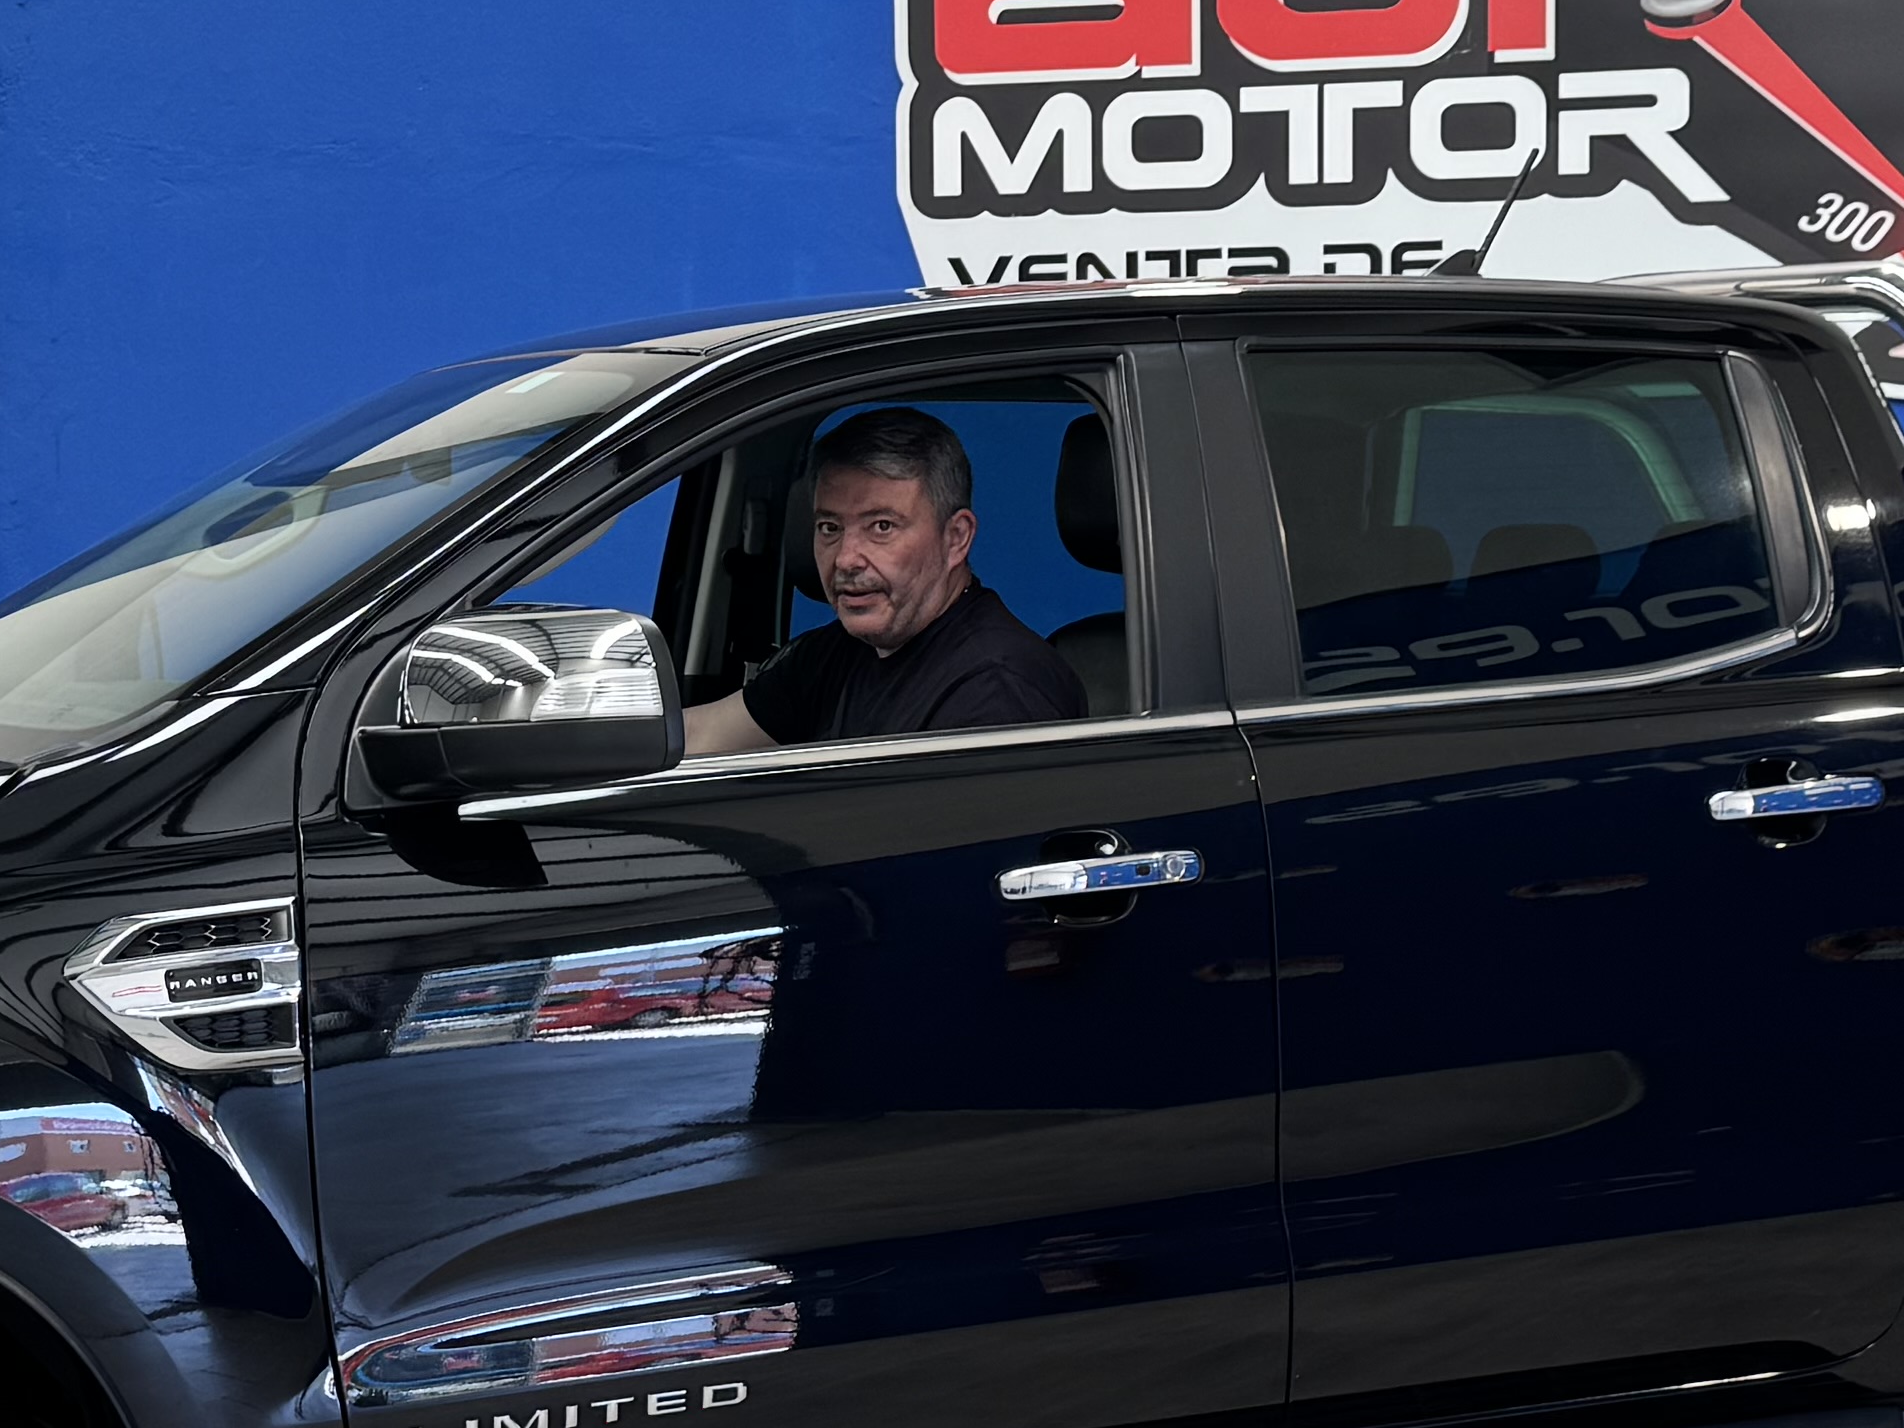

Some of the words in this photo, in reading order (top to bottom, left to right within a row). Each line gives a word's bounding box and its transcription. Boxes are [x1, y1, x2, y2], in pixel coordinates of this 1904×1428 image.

[932, 68, 1731, 202] MOTOR
[1797, 192, 1896, 253] 300
[1323, 240, 1445, 276] DE
